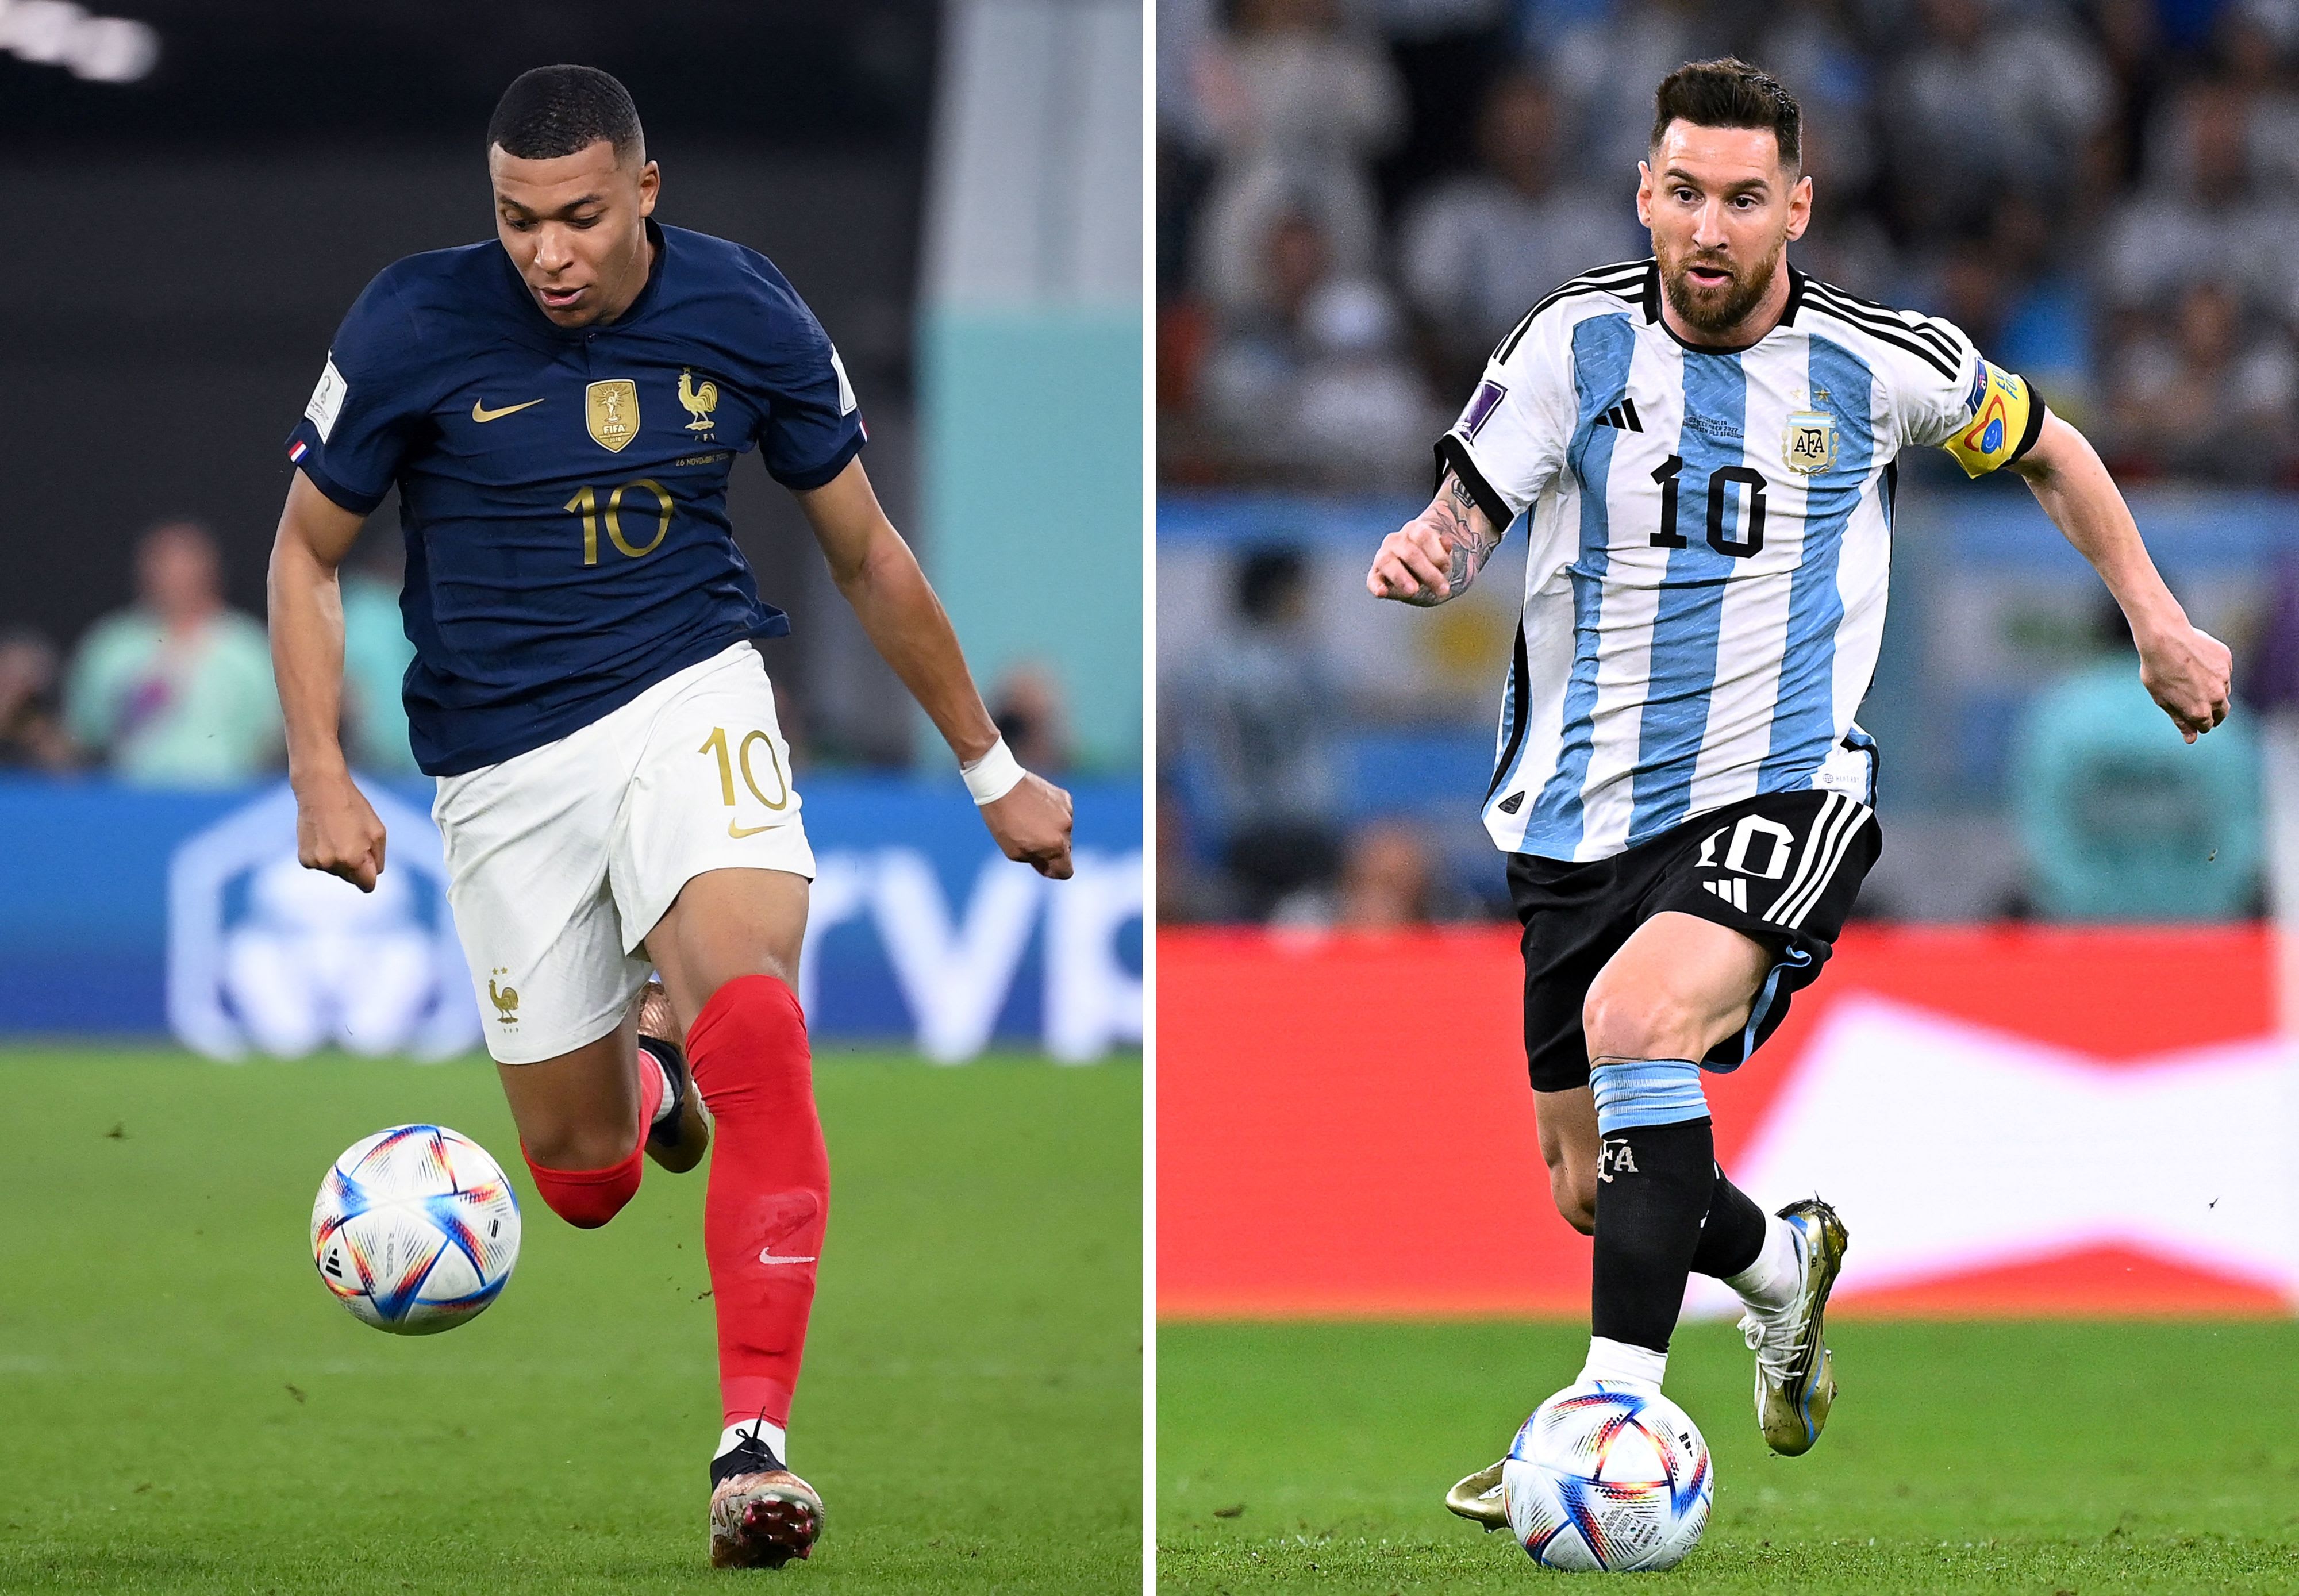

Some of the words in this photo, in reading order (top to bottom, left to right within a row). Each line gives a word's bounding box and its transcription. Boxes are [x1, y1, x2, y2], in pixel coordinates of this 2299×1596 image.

[603, 424, 626, 434] FIFA
[1794, 428, 1825, 459] AFA
[563, 479, 675, 566] 10
[1649, 454, 1768, 559] 10
[697, 726, 787, 811] 10
[1694, 814, 1794, 880] 10
